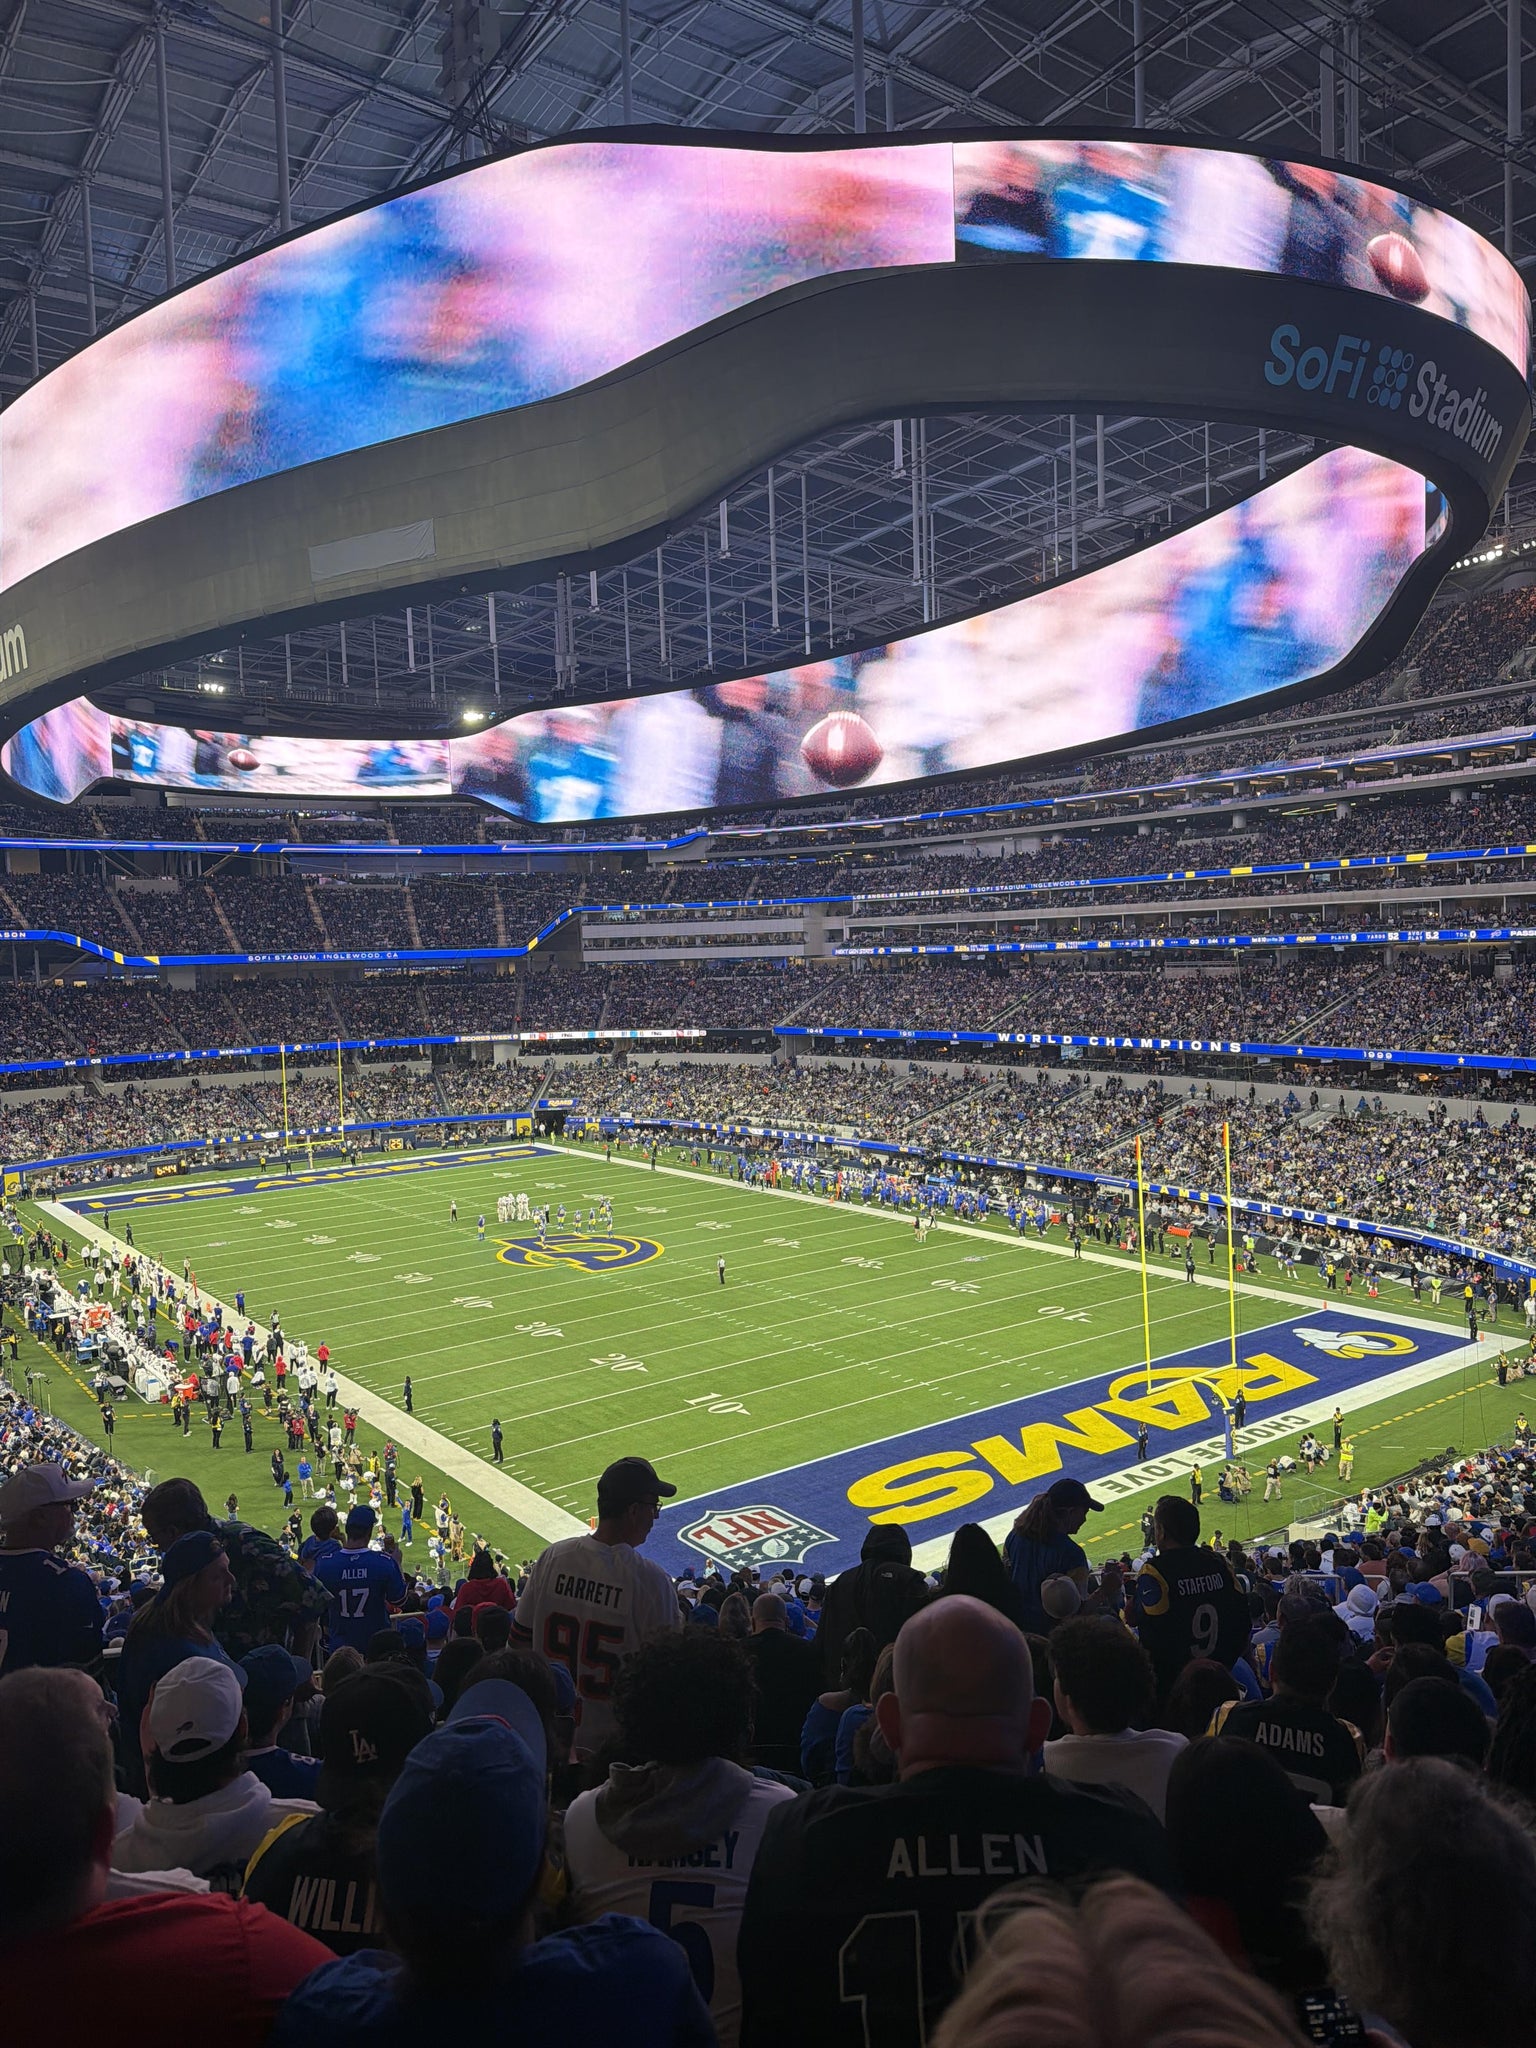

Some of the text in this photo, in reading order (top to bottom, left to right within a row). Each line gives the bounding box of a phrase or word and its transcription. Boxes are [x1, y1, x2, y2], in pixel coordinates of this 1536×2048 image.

[1264, 324, 1503, 463] SoFi Stadium
[941, 887, 970, 895] SEASON
[1350, 933, 1357, 942] 9
[1387, 932, 1399, 941] 52
[1425, 931, 1440, 940] 5.2
[1469, 930, 1477, 939] 0
[998, 1033, 1242, 1053] WORLD CHAMPIONS
[1363, 1050, 1393, 1060] 1999
[206, 1134, 254, 1145] RAMS
[771, 1129, 826, 1142] HOUSE
[87, 1149, 537, 1209] LOS ANGELES
[156, 1164, 177, 1176] 6:44
[1142, 1182, 1359, 1230] RAMS HOUSE
[931, 1279, 980, 1293] 20
[1037, 1306, 1089, 1321] 10
[514, 1321, 562, 1337] 30
[589, 1353, 644, 1372] 20
[683, 1392, 744, 1414] 10
[847, 1353, 1319, 1526] RAMS
[1187, 1414, 1311, 1460] CHOOSE
[1099, 1457, 1194, 1494] LOVE
[691, 1510, 794, 1549] NFL
[341, 1567, 368, 1581] ALLEN
[1177, 1572, 1224, 1597] STAFFORD
[338, 1587, 370, 1618] 17
[555, 1573, 623, 1609] GARRETT
[1190, 1603, 1219, 1658] 9
[543, 1611, 626, 1702] 95
[349, 1728, 379, 1765] LA
[1255, 1720, 1325, 1758] ADAMS
[886, 1832, 1049, 1880] ALLEN
[287, 1874, 384, 1934] WILLI
